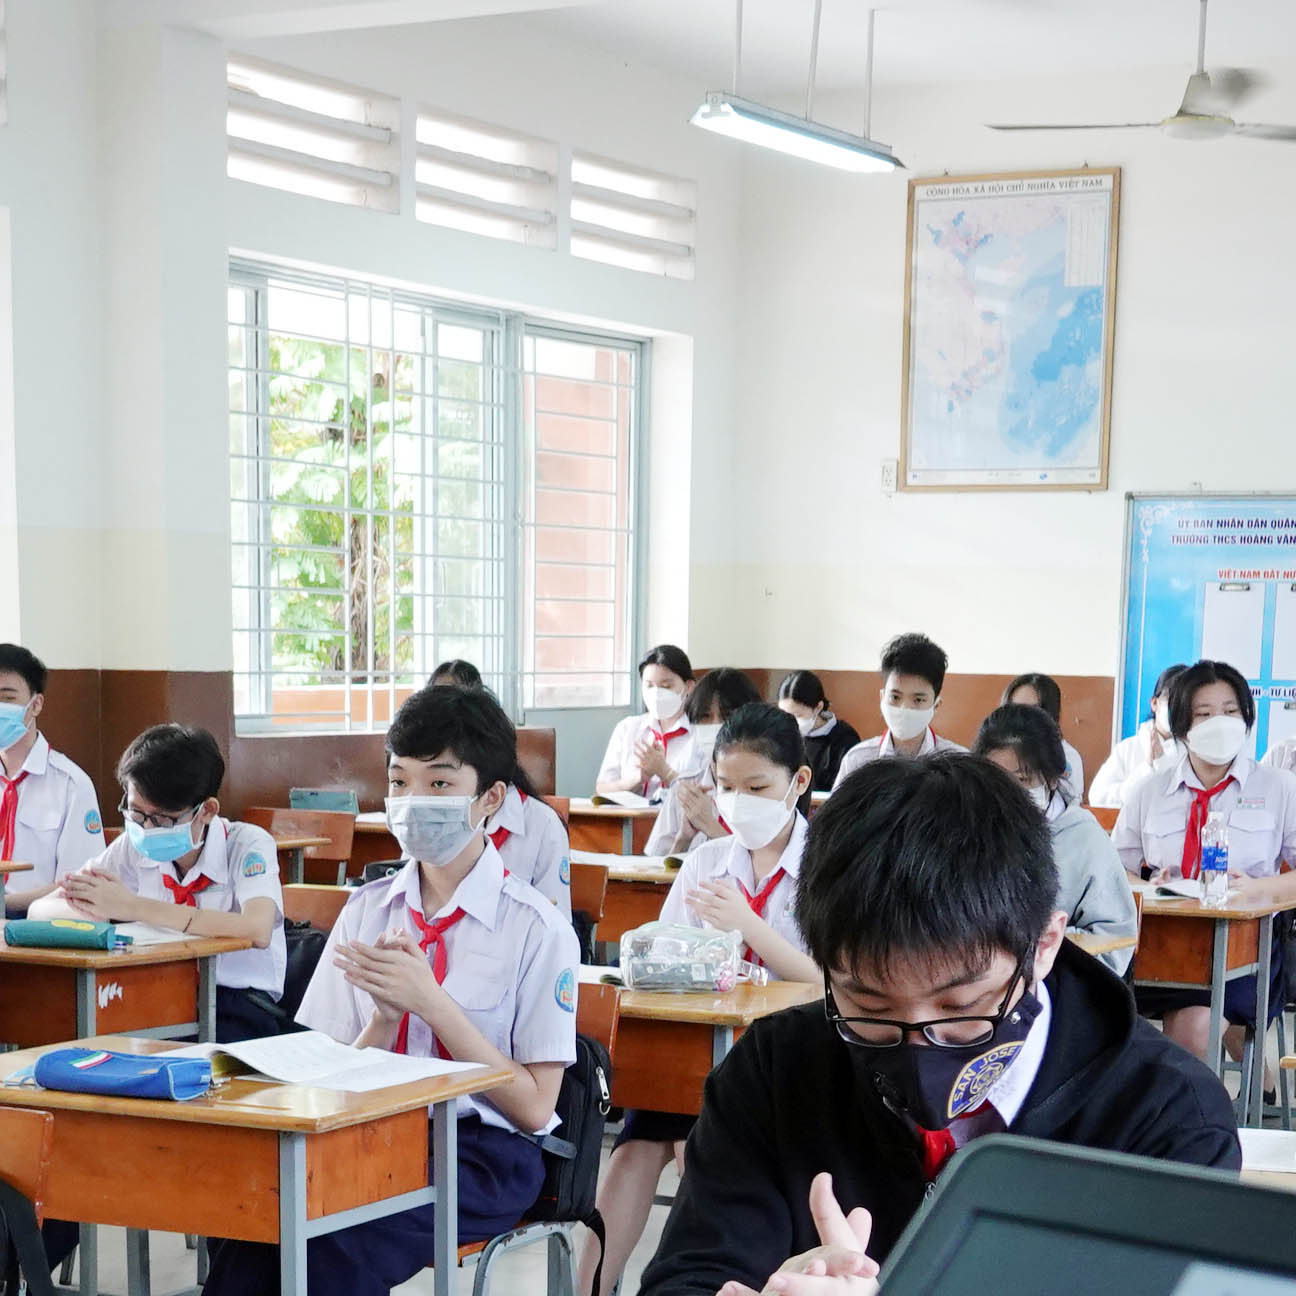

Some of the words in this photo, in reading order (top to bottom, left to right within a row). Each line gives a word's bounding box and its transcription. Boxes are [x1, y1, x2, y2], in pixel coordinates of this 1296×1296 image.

[1082, 179, 1103, 187] NAM
[1213, 535, 1236, 544] THCS
[1240, 569, 1261, 579] NAM
[953, 1068, 977, 1101] SAN
[979, 1046, 1016, 1070] JOSE
